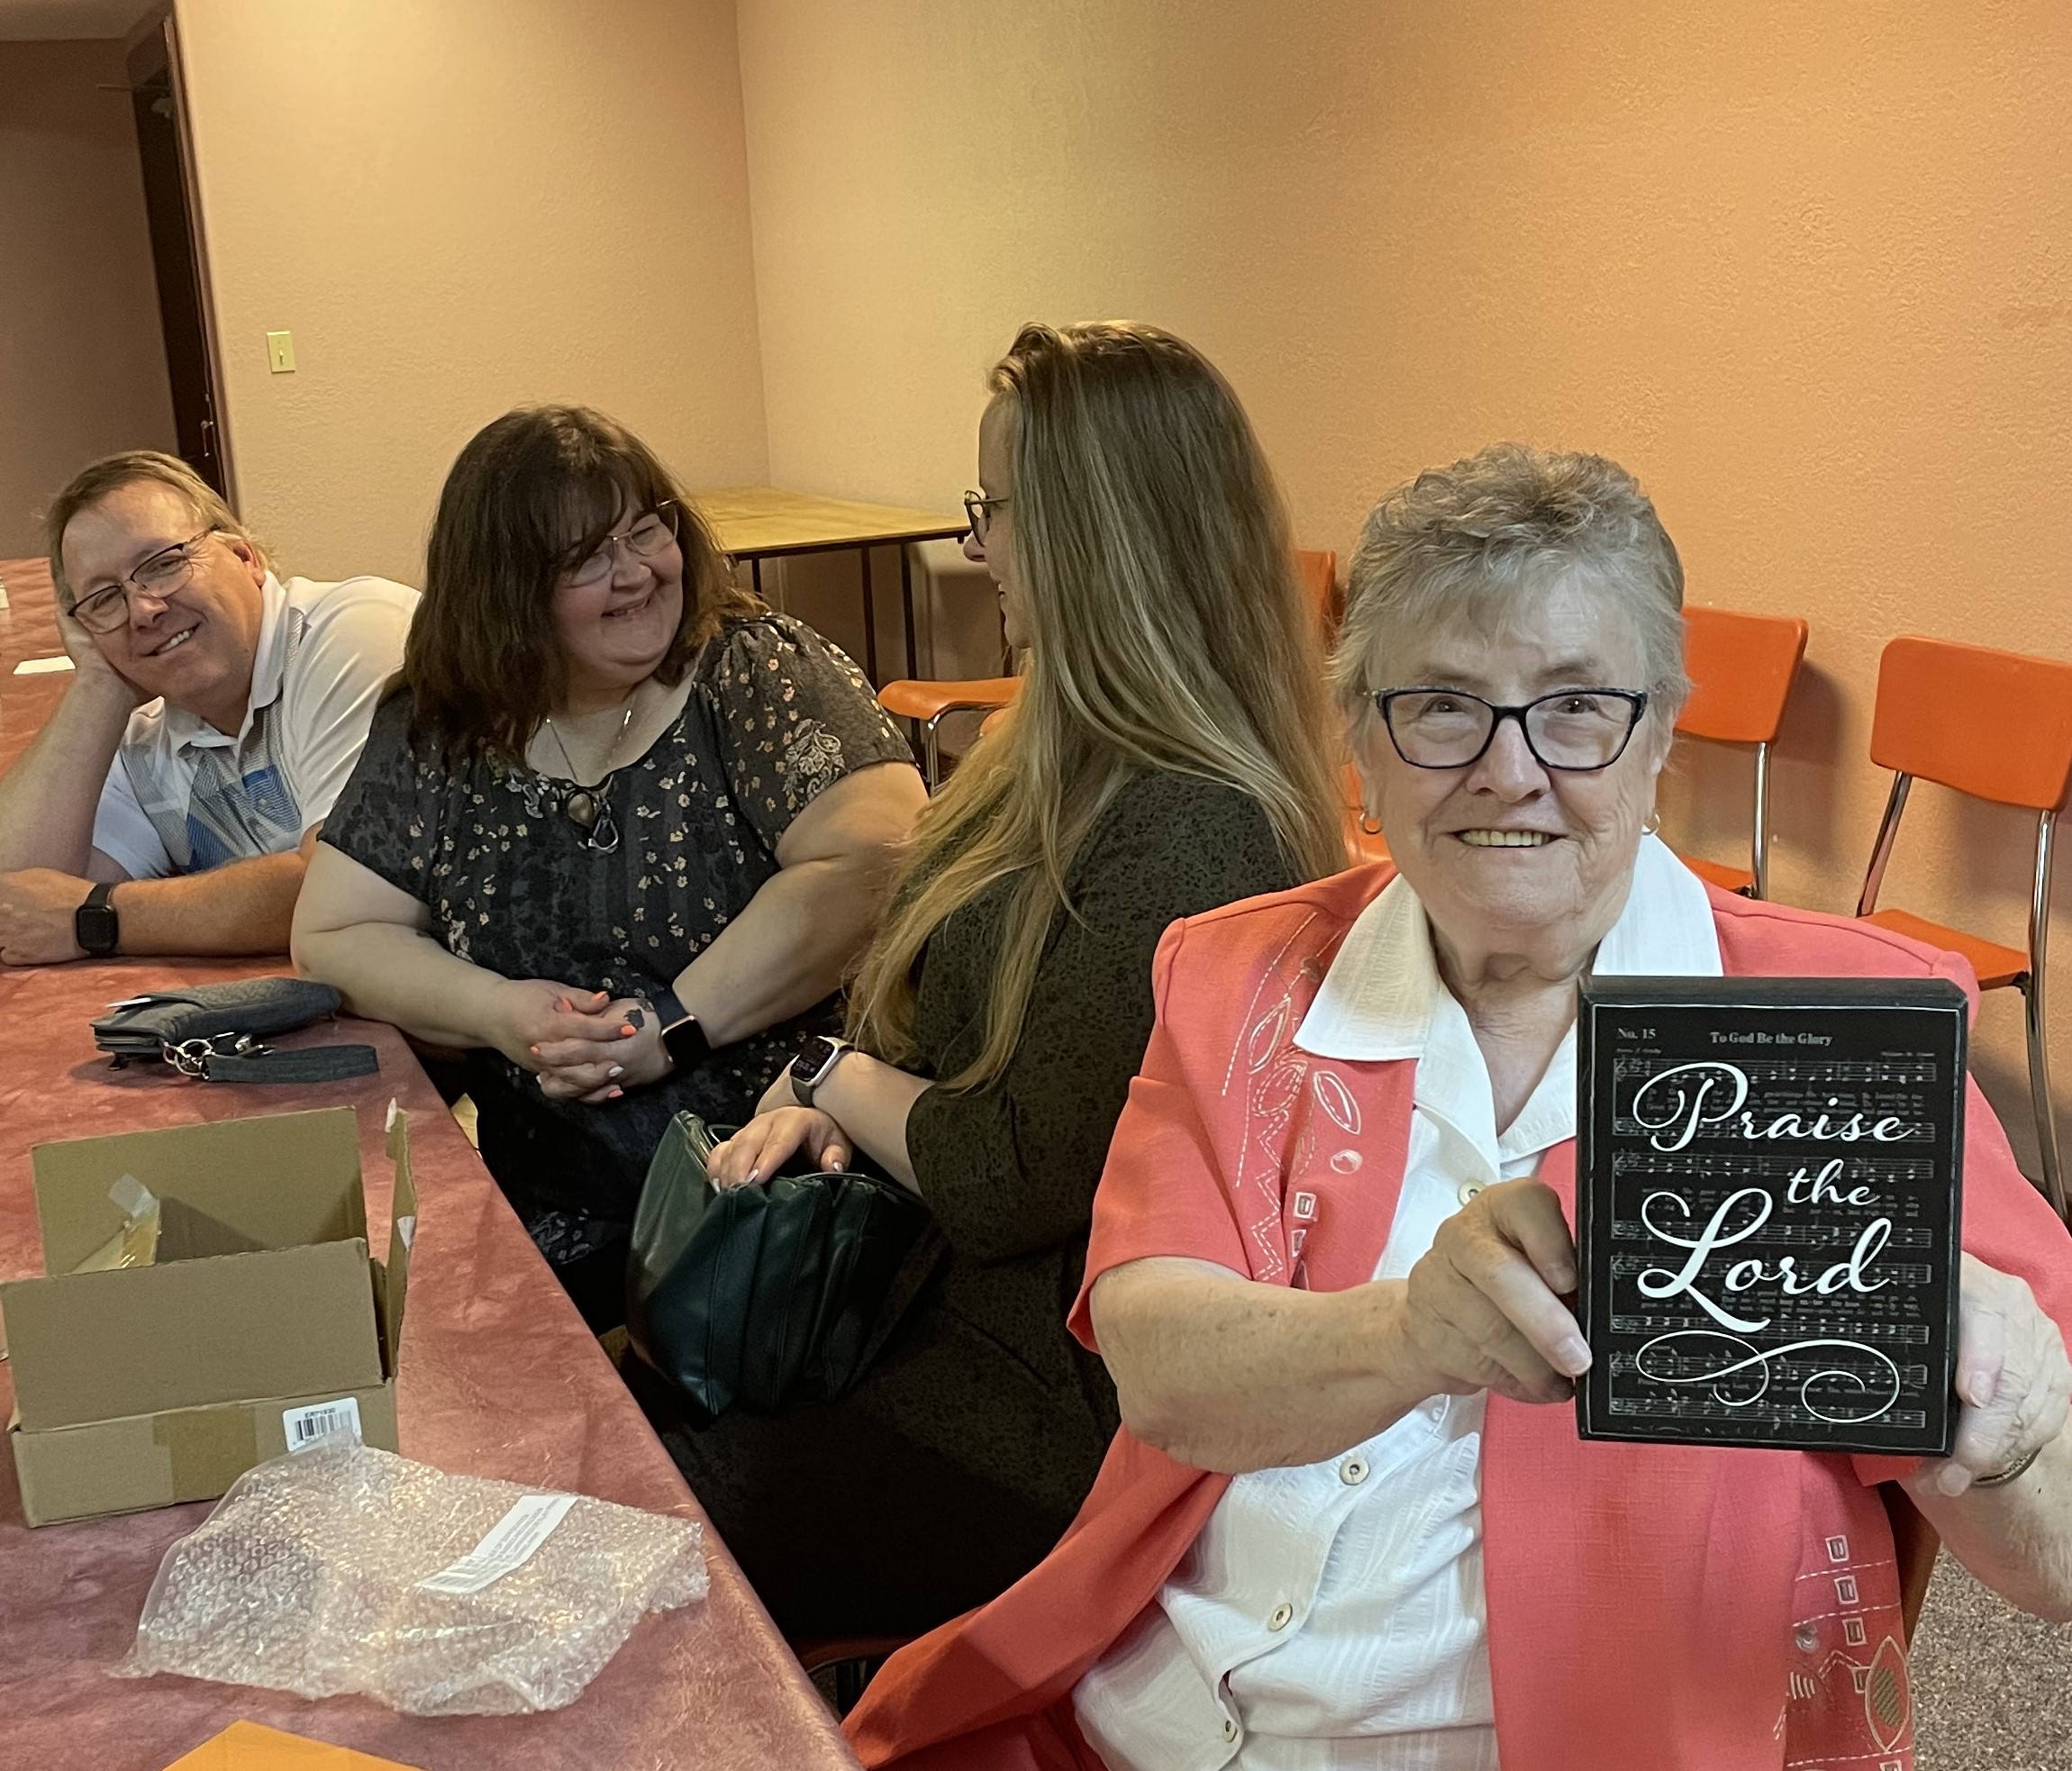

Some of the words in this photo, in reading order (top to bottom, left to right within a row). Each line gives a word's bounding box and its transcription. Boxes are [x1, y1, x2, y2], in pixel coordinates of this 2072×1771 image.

[1642, 1028, 1657, 1040] 15
[1709, 1031, 1727, 1043] To
[1729, 1031, 1754, 1043] God
[1756, 1032, 1774, 1044] Be
[1775, 1032, 1795, 1044] the
[1797, 1032, 1832, 1046] Glory
[1632, 1062, 1915, 1152] Praise
[1786, 1158, 1881, 1206] the
[1637, 1187, 1892, 1333] Lord
